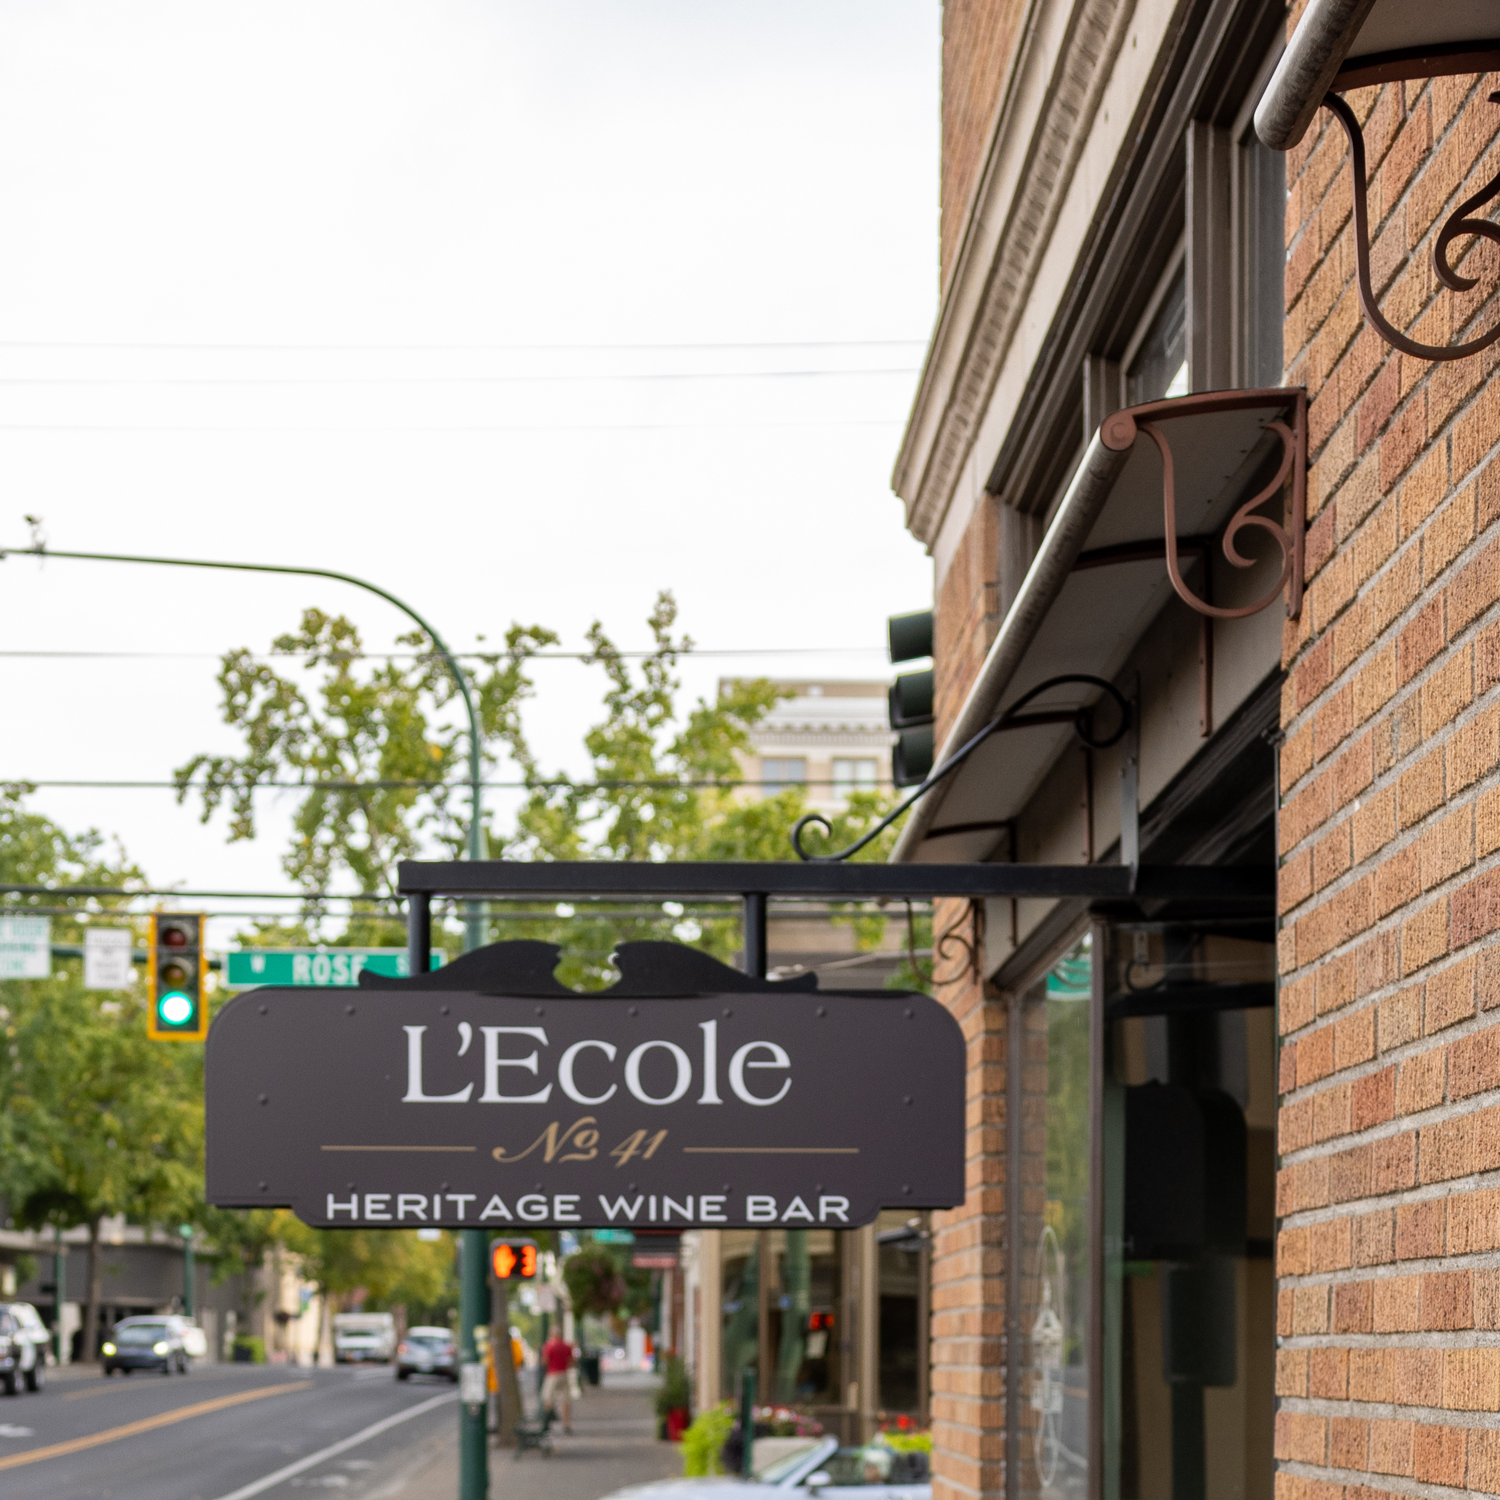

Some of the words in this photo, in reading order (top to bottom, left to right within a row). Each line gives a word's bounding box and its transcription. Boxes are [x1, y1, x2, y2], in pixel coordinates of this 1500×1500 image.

[401, 1019, 793, 1107] L'Ecole
[611, 1128, 670, 1169] 41
[326, 1193, 581, 1222] HERITAGE
[598, 1194, 728, 1223] WINE
[746, 1195, 850, 1223] BAR
